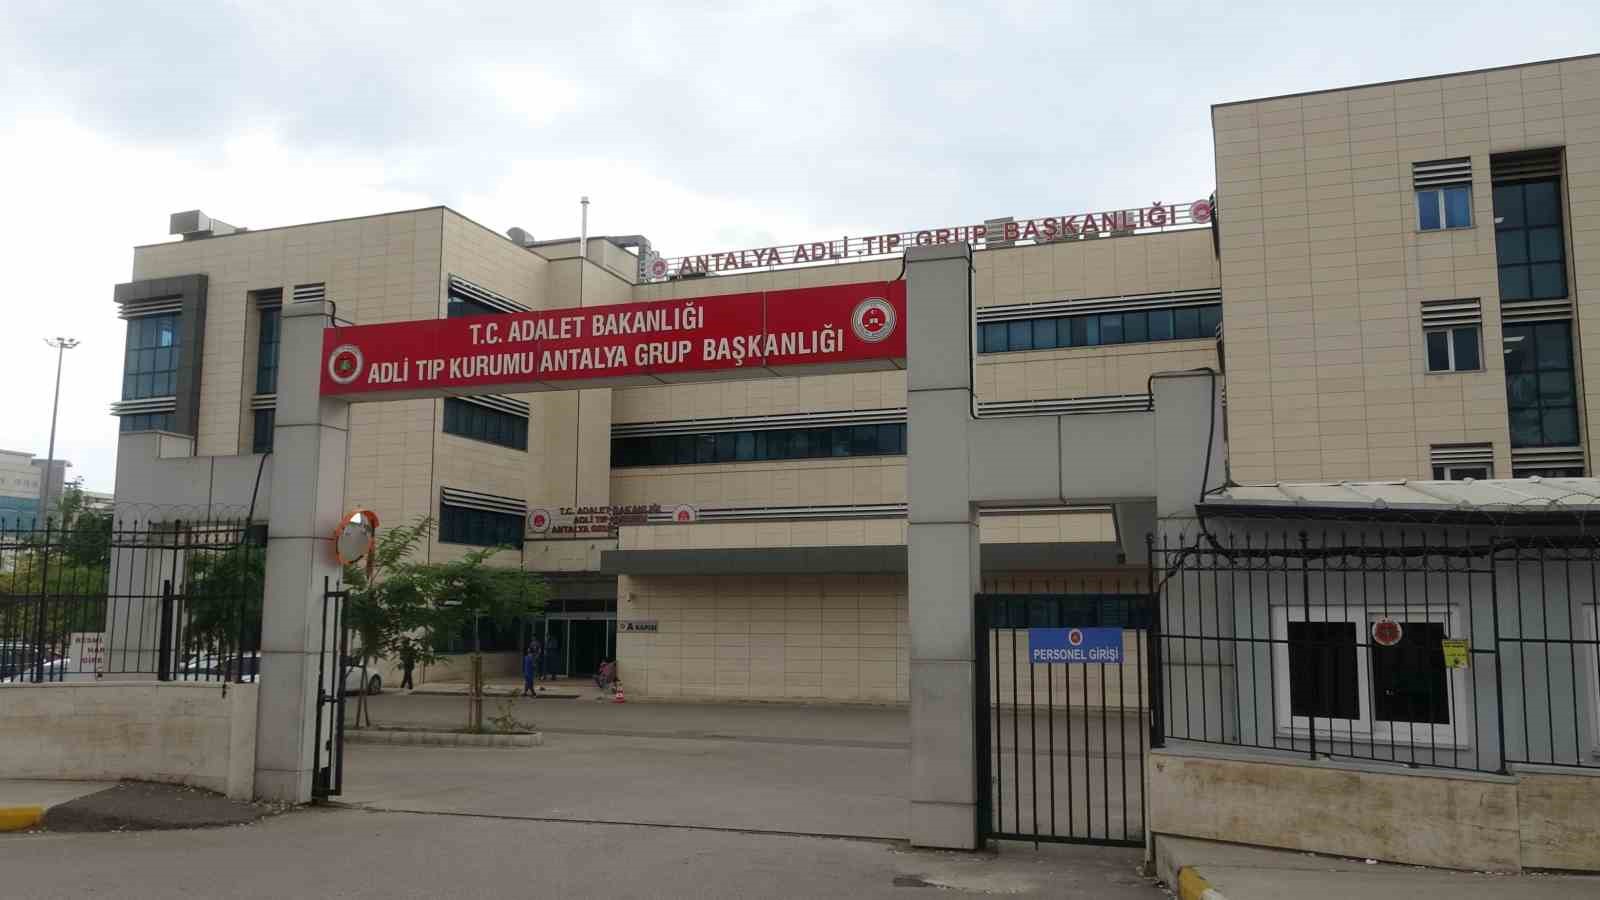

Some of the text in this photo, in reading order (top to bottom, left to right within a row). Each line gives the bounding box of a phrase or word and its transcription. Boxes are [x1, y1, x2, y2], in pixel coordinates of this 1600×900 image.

[680, 201, 1176, 274] ANTALYA ADLİ TIP GRUP BAŞKANLIĞI
[469, 302, 704, 345] T.C. ADALET BAKANLIĞI
[367, 323, 844, 384] ADLİ TIP KURUMU ANTALYA GRUP BAŞKANLIĞI
[1033, 645, 1119, 662] PERSONEL GİRİŞİ
